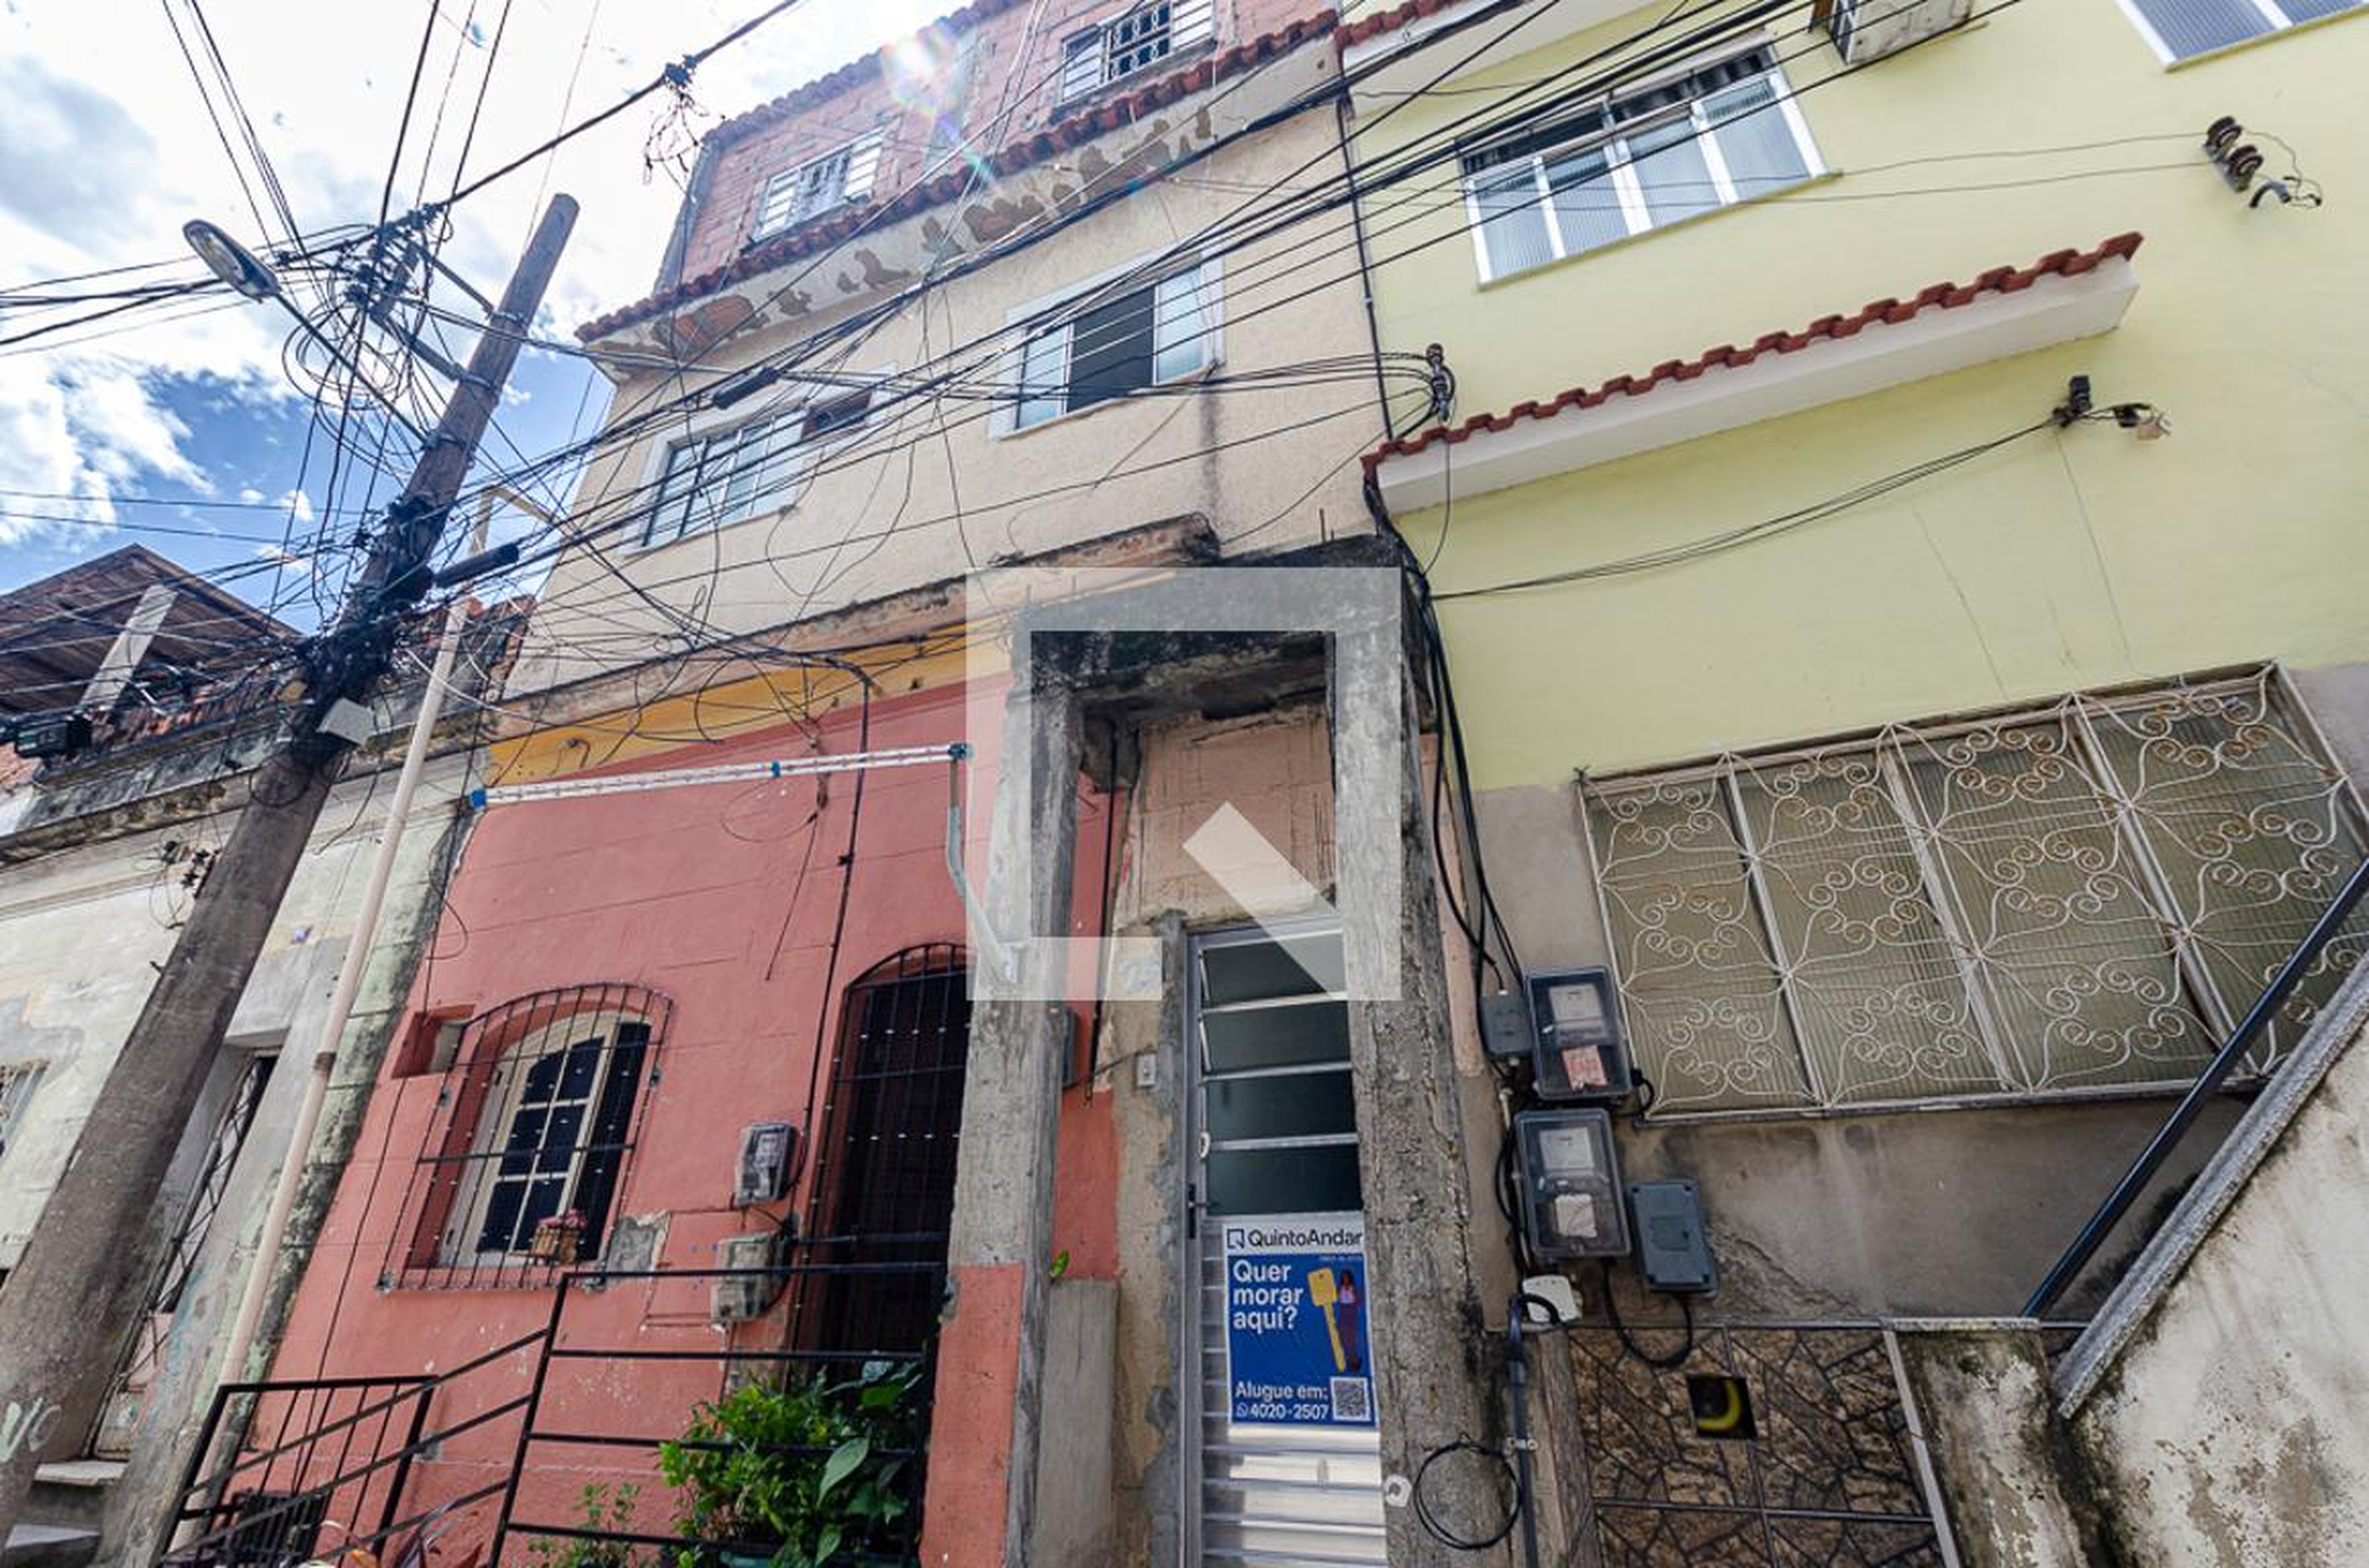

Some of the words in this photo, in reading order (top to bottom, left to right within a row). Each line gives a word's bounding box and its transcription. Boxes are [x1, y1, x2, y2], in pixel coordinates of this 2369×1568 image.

[1247, 1229, 1363, 1247] QuintoAndar
[1233, 1260, 1291, 1282] Quer
[1233, 1287, 1304, 1305] morar
[1233, 1306, 1298, 1334] aqui?
[1235, 1381, 1294, 1402] Alugue
[1296, 1385, 1328, 1400] em:
[1250, 1403, 1329, 1419] 4020-2507
